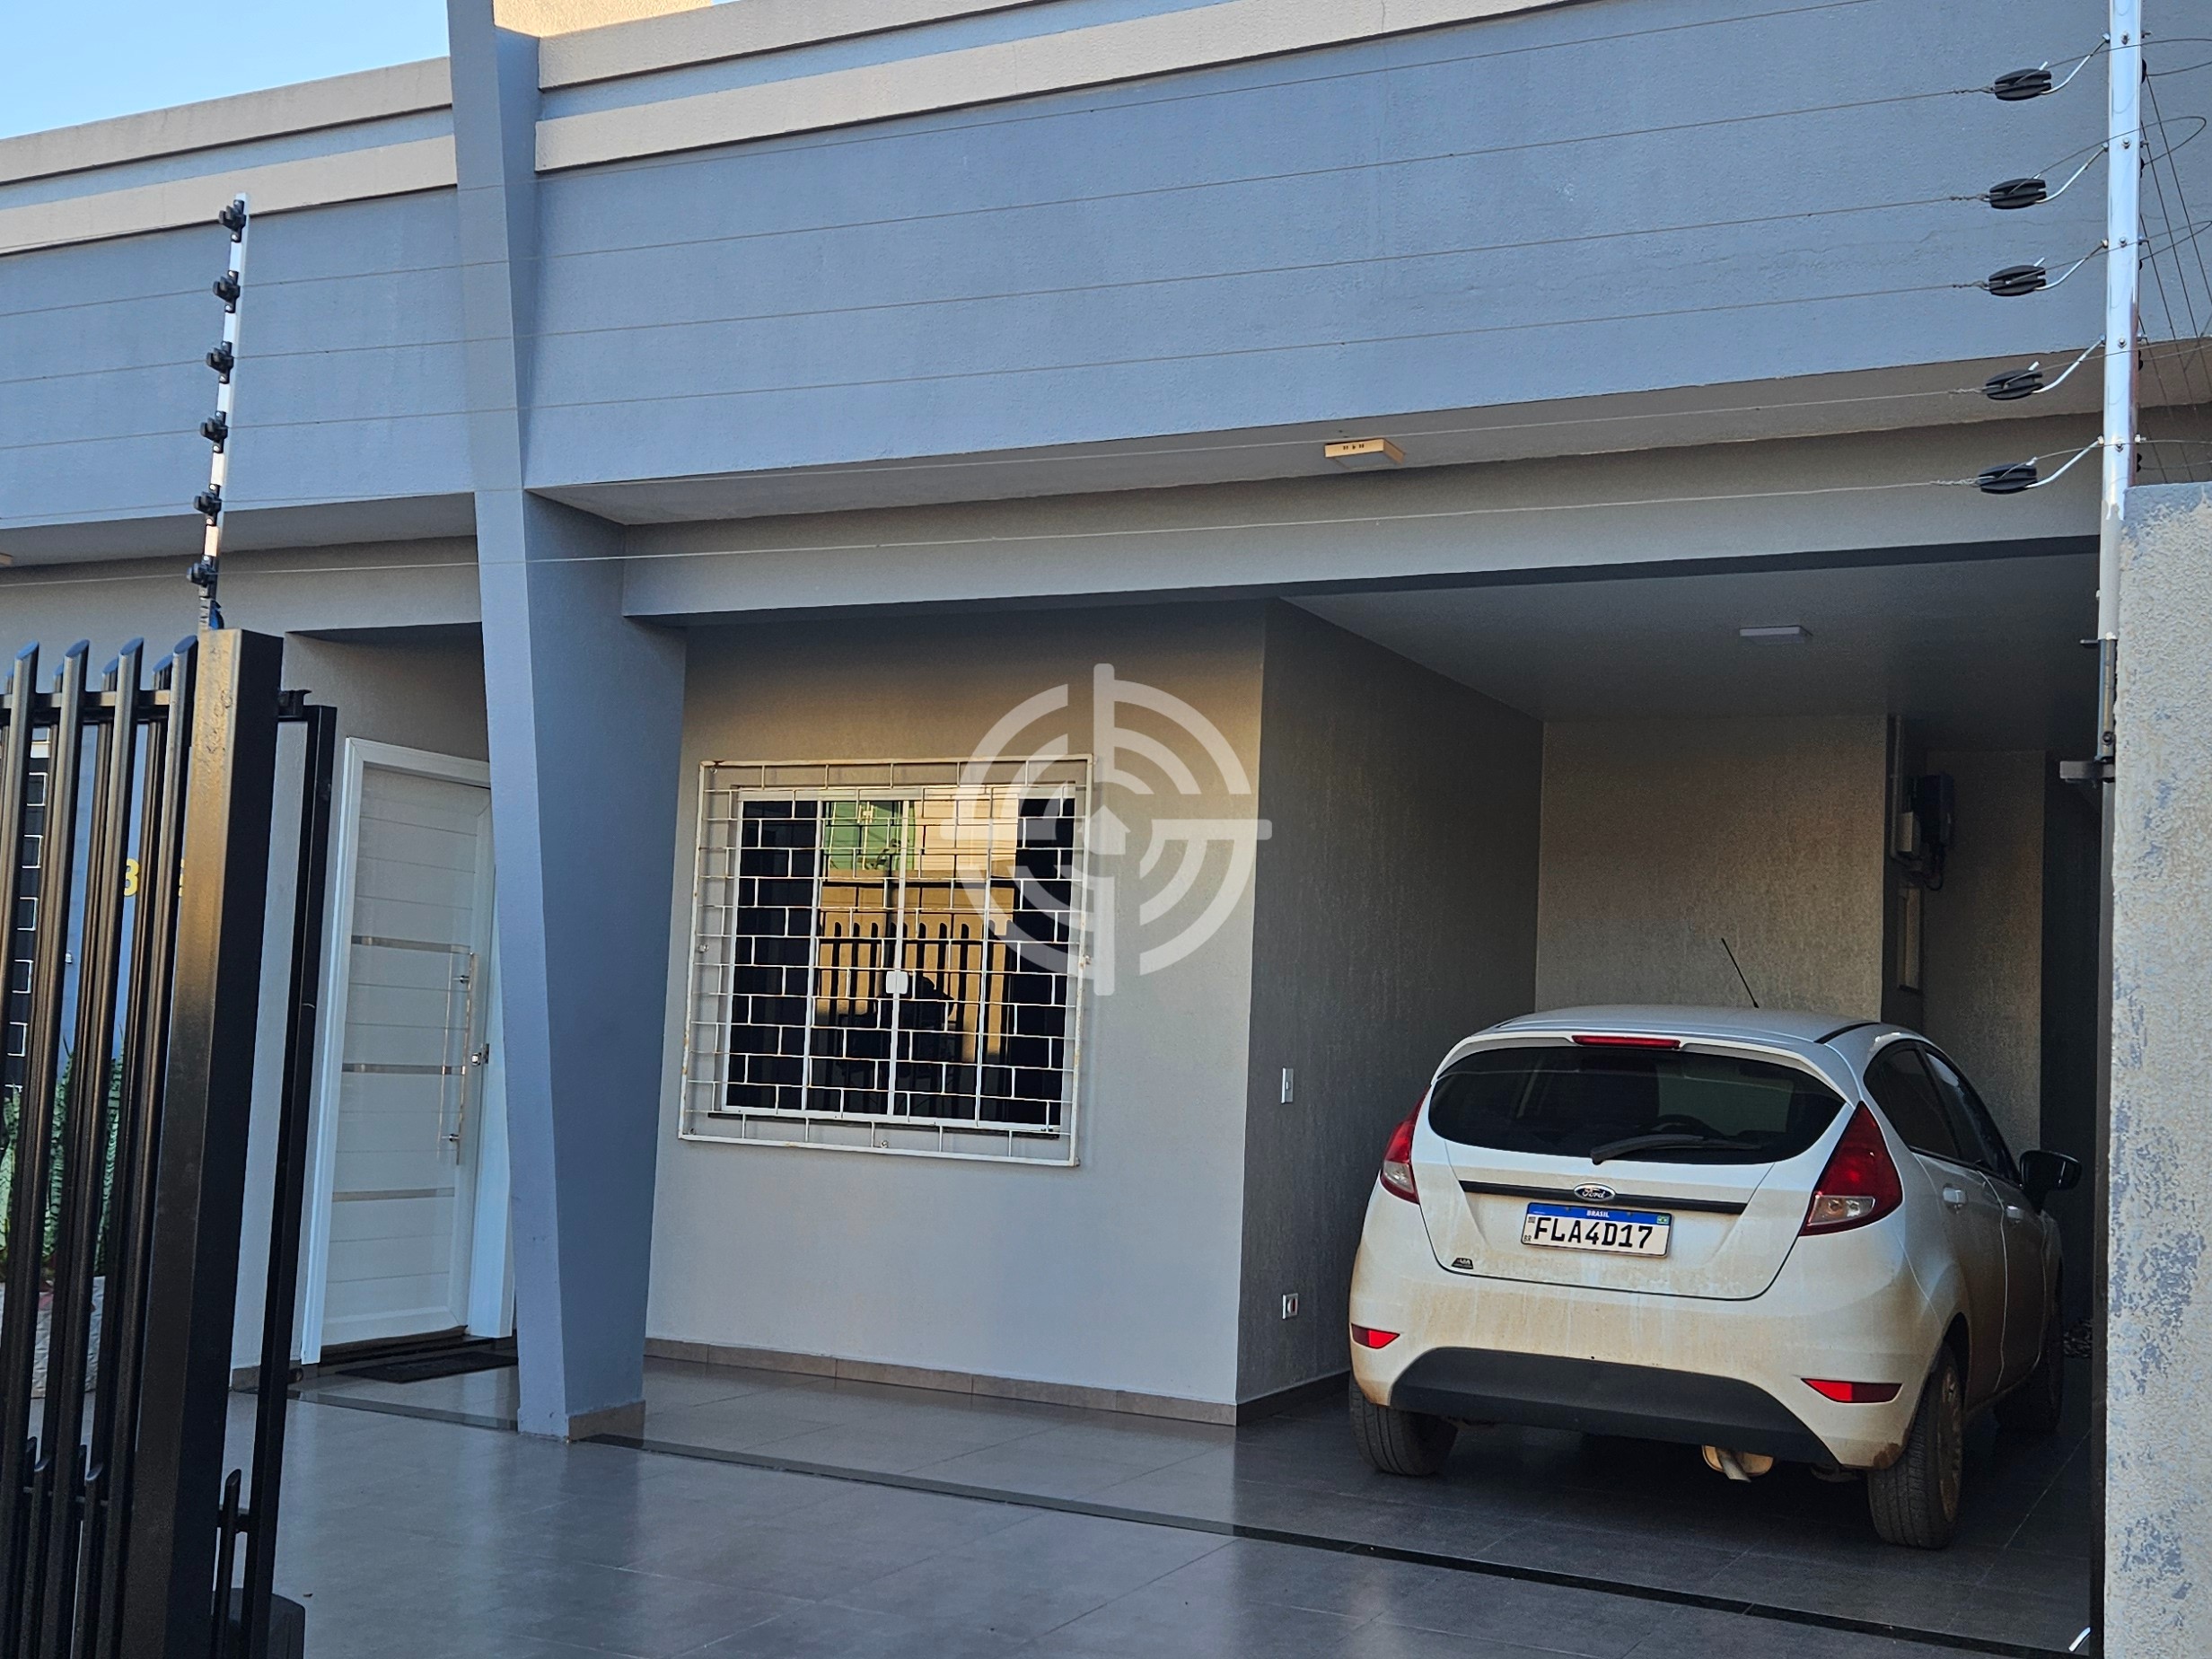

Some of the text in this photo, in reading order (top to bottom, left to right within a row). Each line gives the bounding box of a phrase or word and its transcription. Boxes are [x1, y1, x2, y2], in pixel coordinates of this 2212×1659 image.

[1582, 1187, 1606, 1198] Ford
[1586, 1210, 1610, 1218] BRASIL
[1534, 1216, 1653, 1249] FLA4D17
